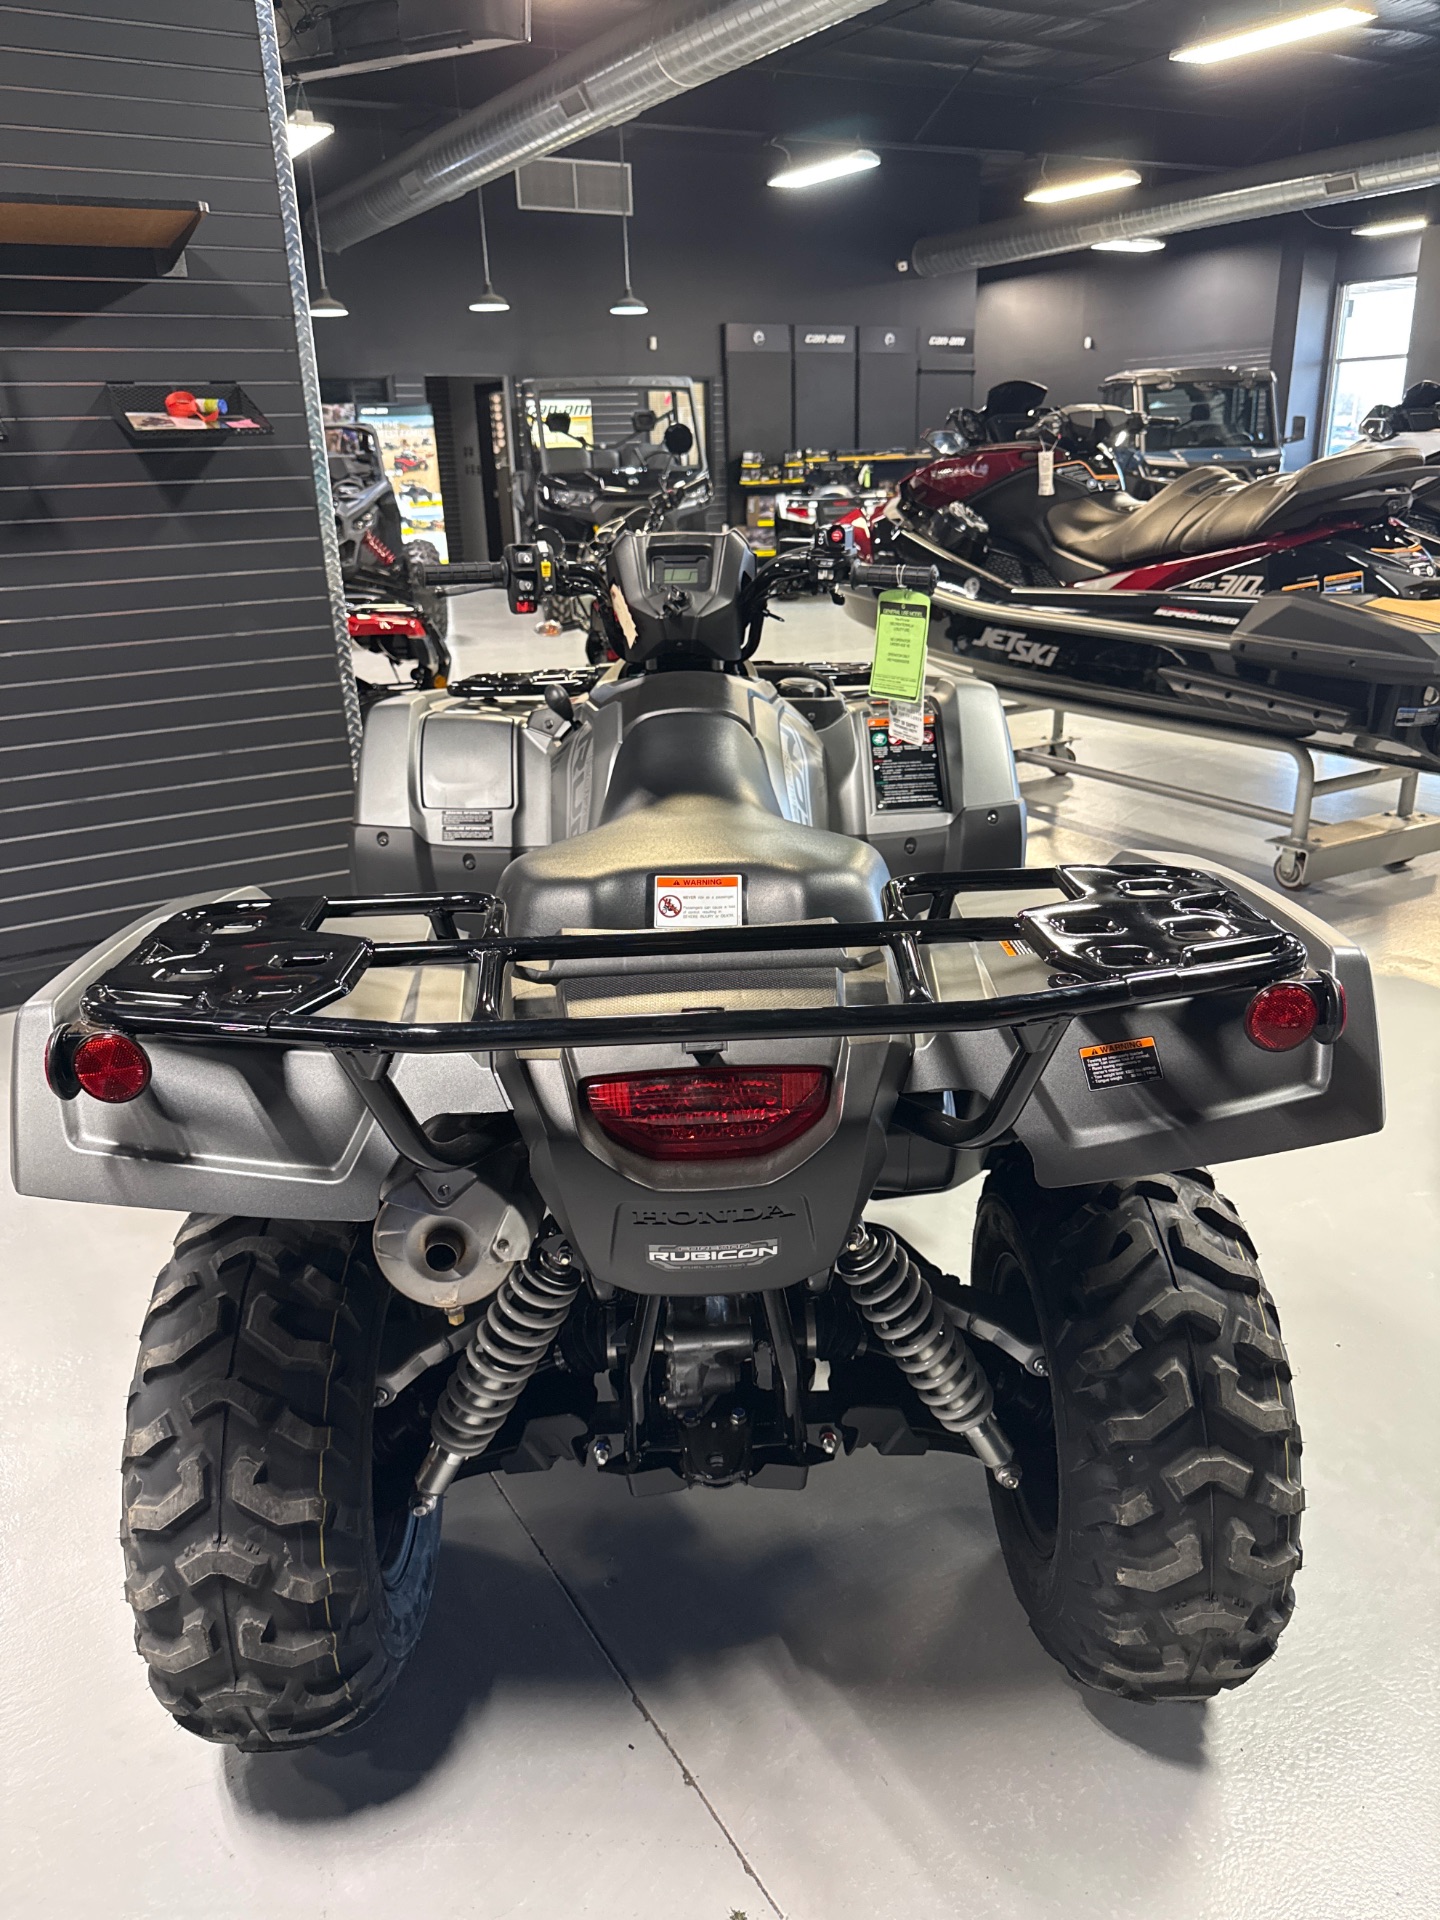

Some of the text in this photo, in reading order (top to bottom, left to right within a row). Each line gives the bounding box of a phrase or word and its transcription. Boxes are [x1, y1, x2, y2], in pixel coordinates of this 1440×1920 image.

[1211, 575, 1264, 596] 310
[1154, 608, 1240, 625] SUPERCHARGED
[683, 878, 722, 886] WARNING
[1099, 1040, 1142, 1053] WARNING
[632, 1205, 796, 1226] HONDA
[649, 1245, 778, 1262] RUBICON
